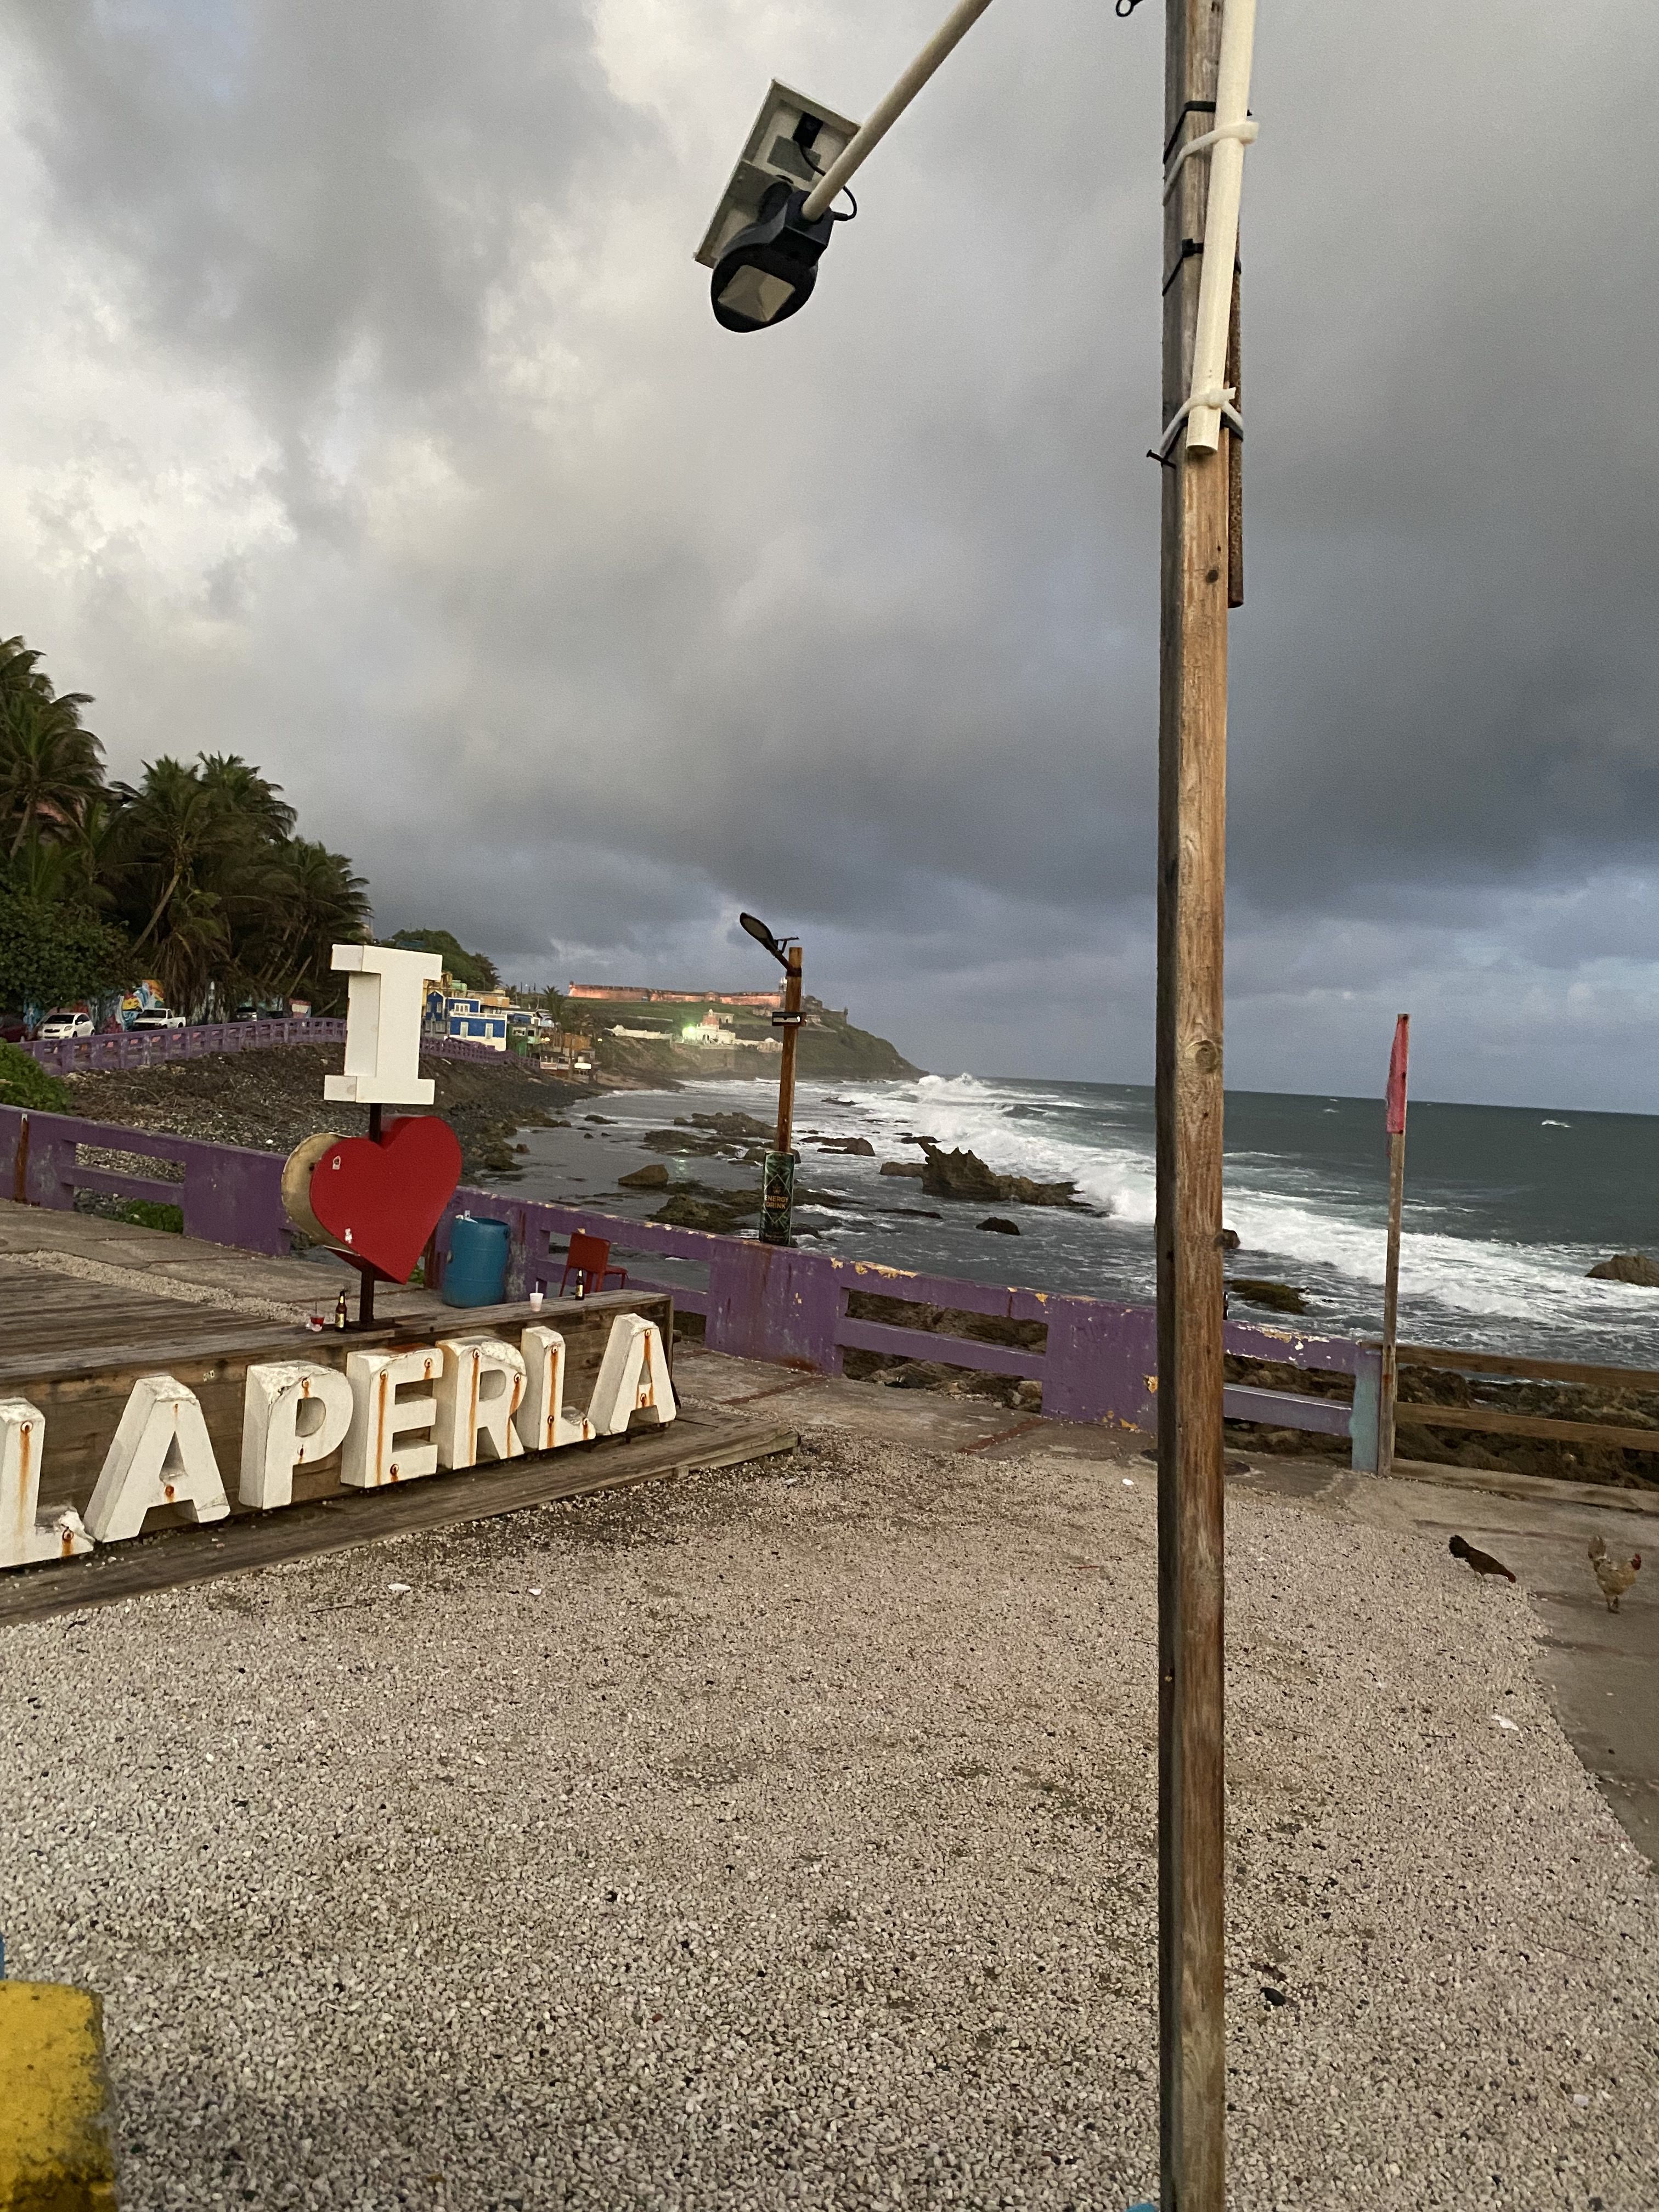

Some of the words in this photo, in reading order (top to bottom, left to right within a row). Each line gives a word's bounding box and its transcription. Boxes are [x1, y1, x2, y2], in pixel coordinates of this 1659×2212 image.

[324, 945, 442, 1105] I
[764, 1194, 788, 1203] ENERGY
[0, 1375, 230, 1568] LA
[239, 1313, 677, 1510] PERLA
